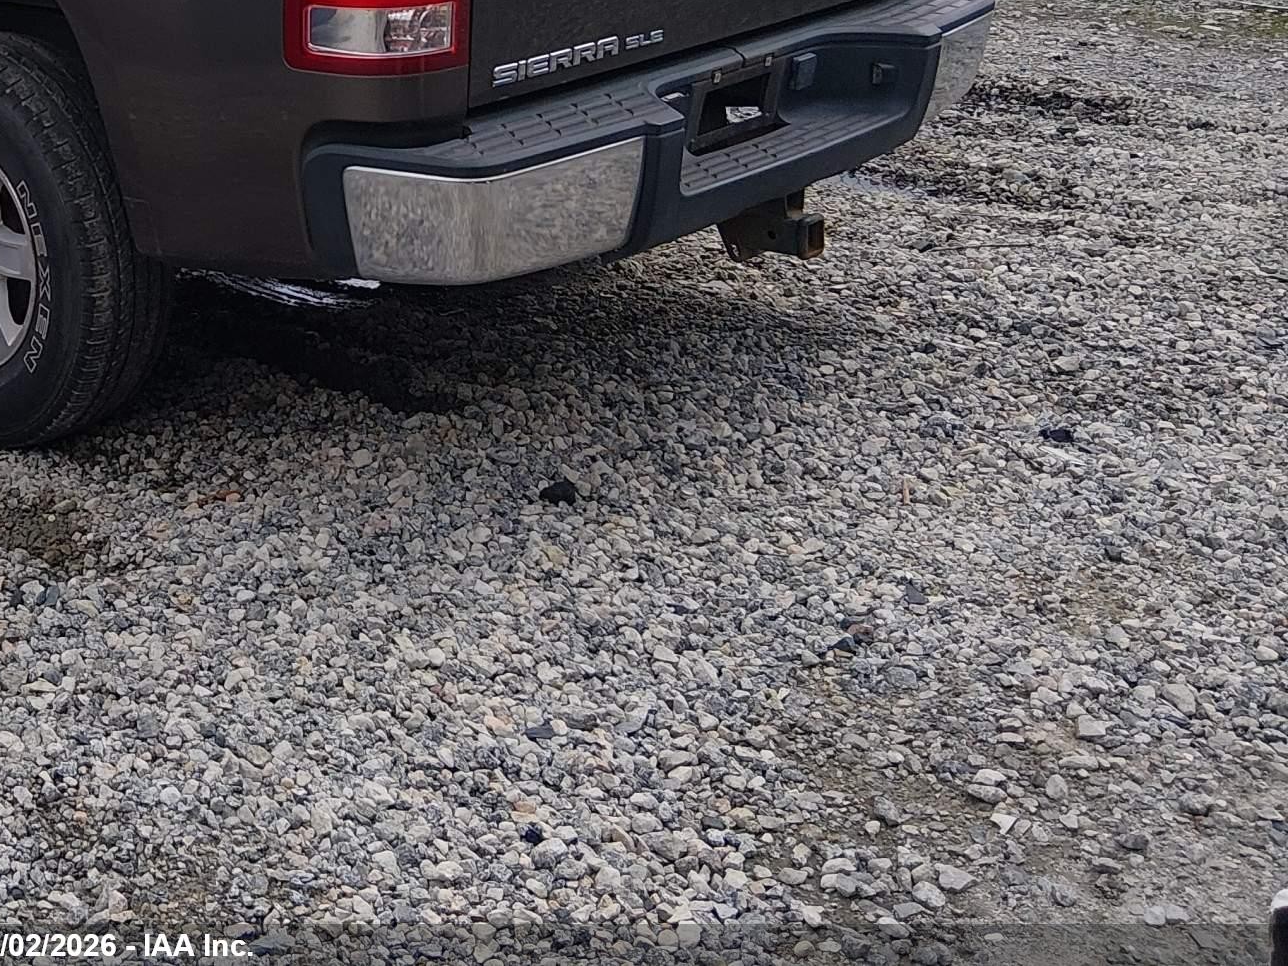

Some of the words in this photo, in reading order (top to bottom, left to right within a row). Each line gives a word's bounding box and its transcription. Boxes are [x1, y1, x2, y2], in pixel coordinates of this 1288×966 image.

[492, 35, 619, 87] SIERRA
[625, 29, 664, 50] SLE
[16, 179, 52, 373] NEXEN
